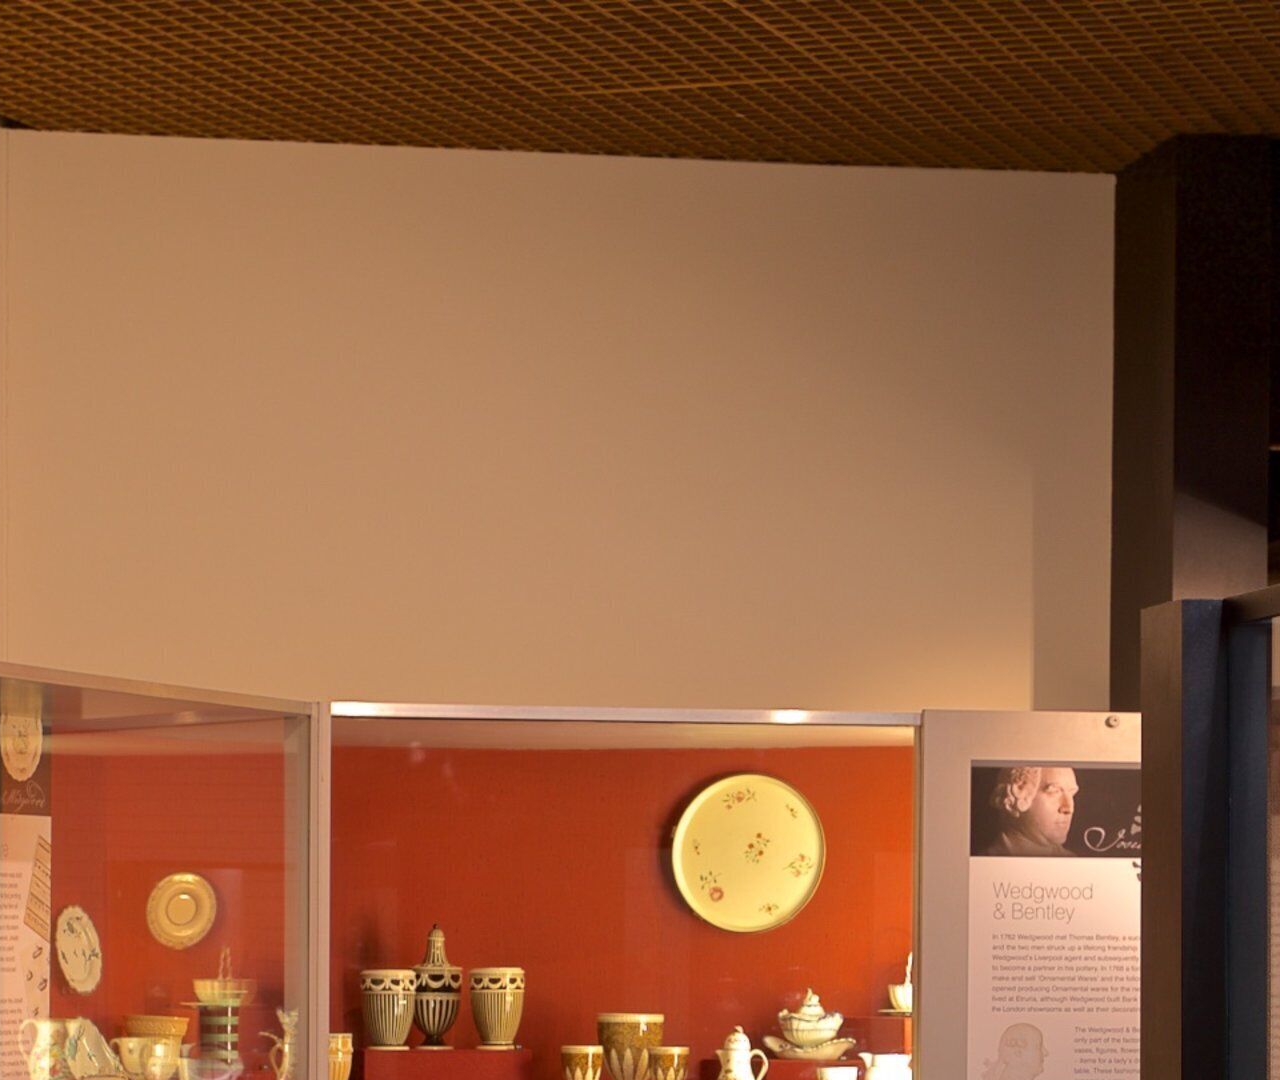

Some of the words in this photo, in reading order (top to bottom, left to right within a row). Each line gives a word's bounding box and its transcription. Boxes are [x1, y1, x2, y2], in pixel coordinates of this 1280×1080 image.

[993, 882, 1093, 903] Wedgwood
[993, 903, 1006, 920] &
[1011, 903, 1075, 922] Bentley
